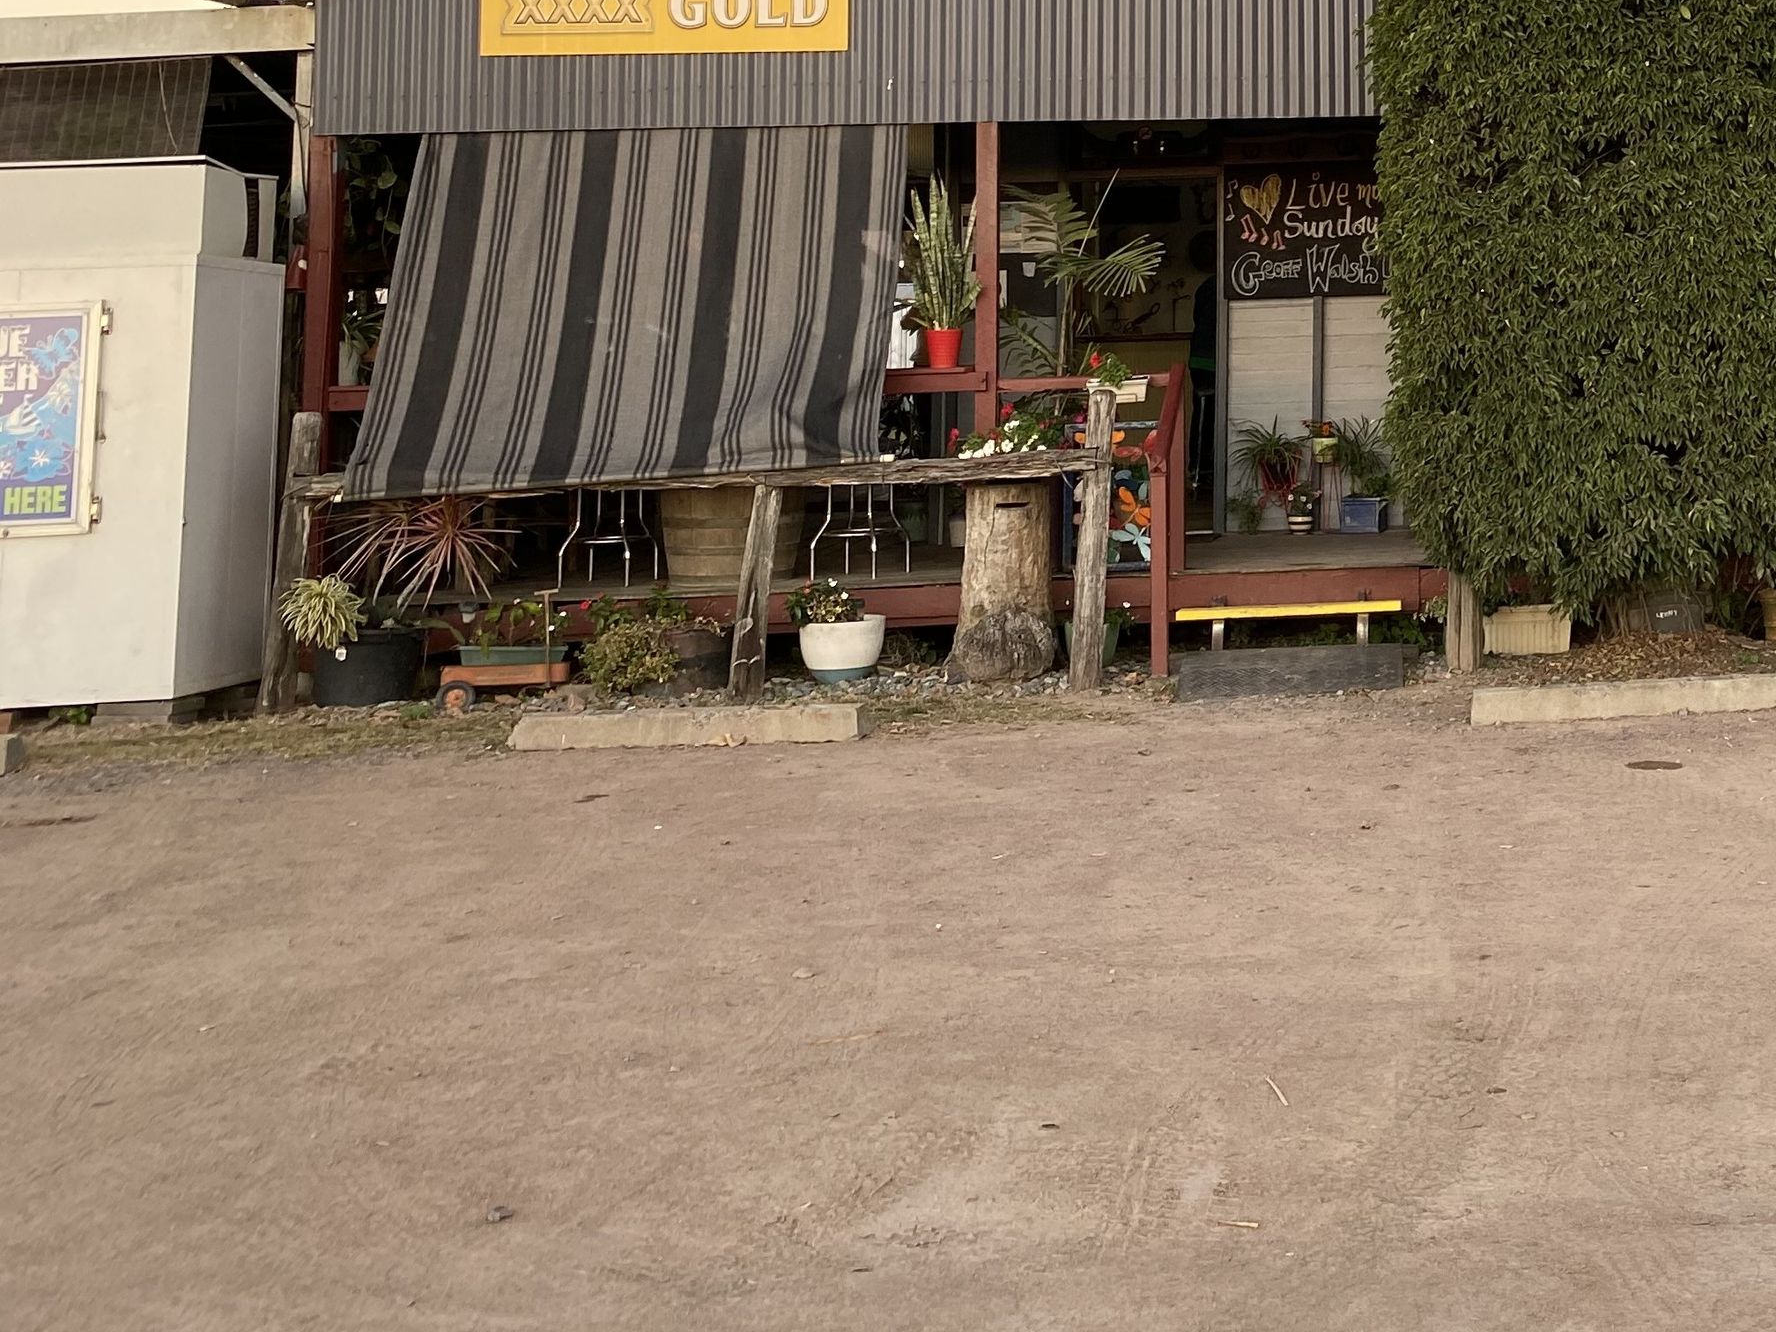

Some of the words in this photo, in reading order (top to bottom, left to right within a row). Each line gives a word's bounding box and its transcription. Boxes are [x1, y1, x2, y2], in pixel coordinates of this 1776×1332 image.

[1286, 171, 1349, 210] Live
[1306, 243, 1380, 294] Walsh
[4, 484, 67, 516] HERE
